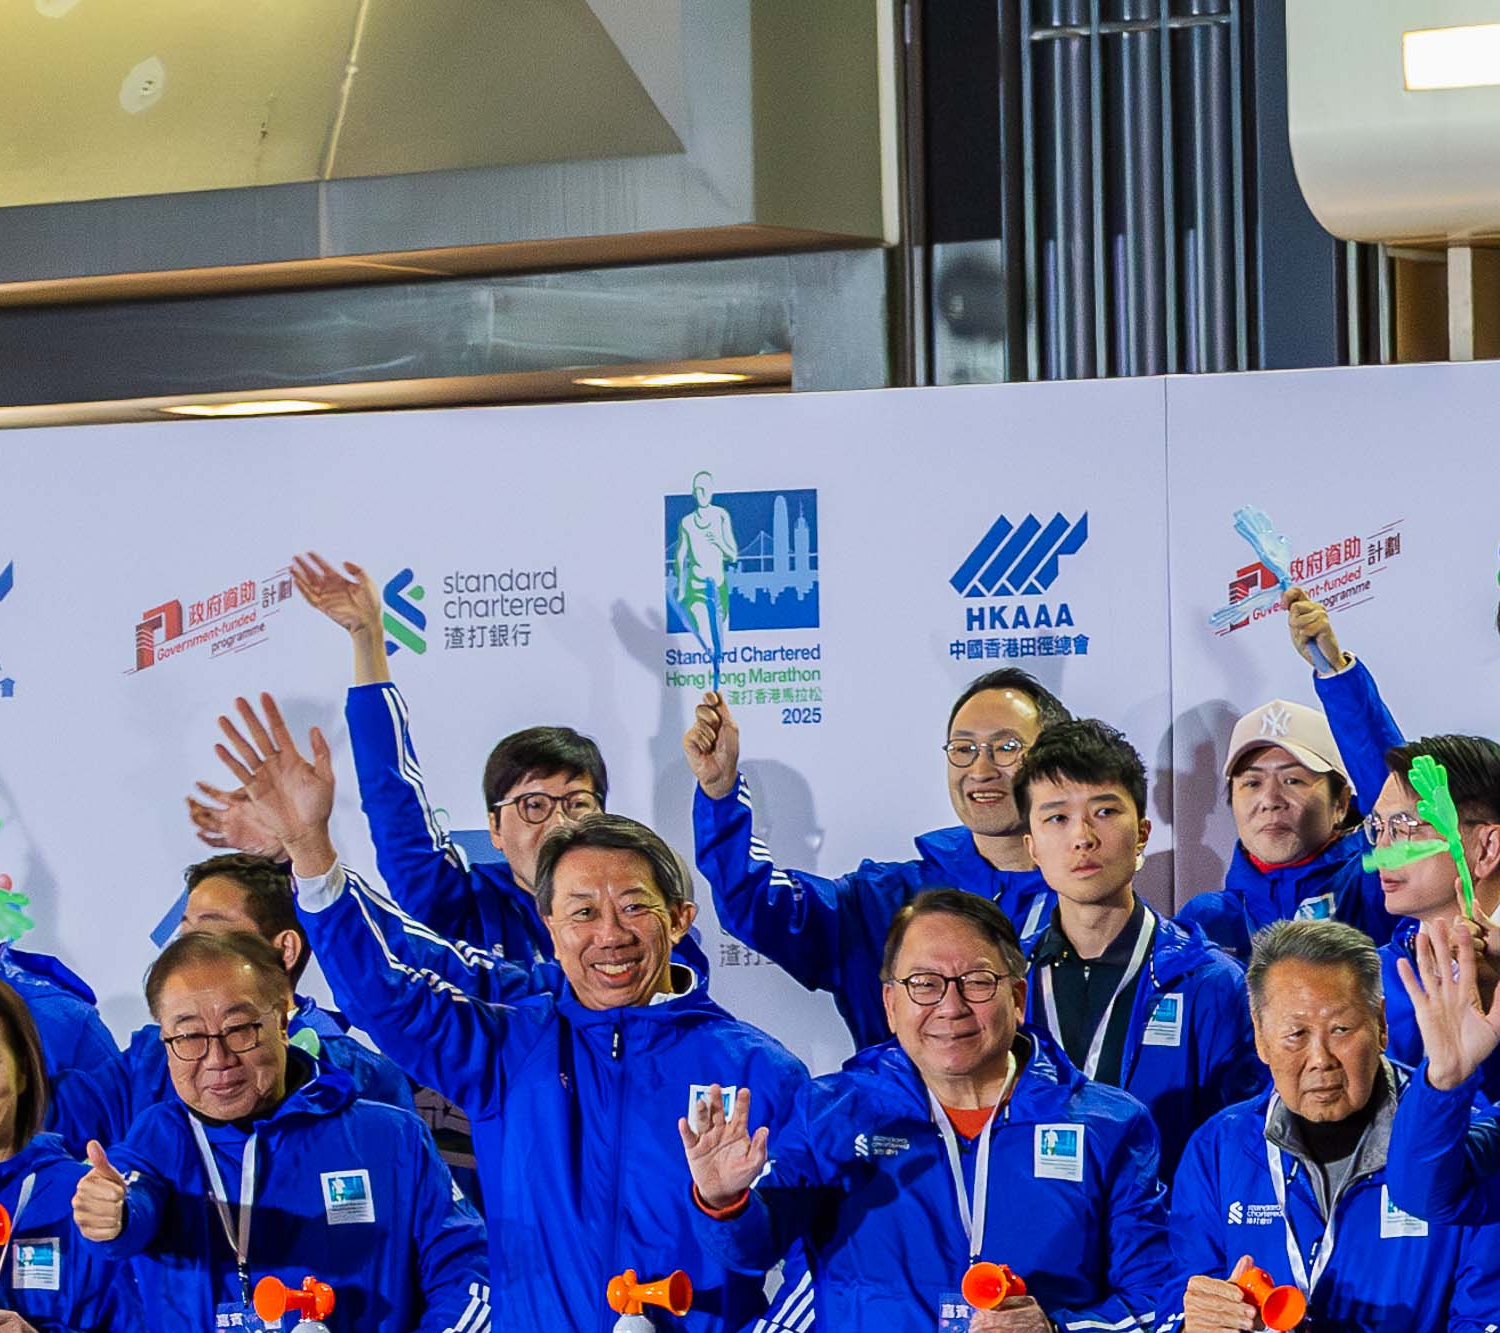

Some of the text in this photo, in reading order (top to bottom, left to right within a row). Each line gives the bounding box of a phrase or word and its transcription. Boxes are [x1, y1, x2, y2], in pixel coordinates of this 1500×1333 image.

[1367, 530, 1402, 568] 計劃
[443, 565, 558, 593] standard
[188, 579, 257, 626] 政府資助
[443, 590, 566, 619] chartered
[966, 602, 1075, 632] HKAAA
[156, 611, 257, 662] Government-funded
[211, 622, 267, 655] programme
[443, 623, 532, 650] 渣打銀行
[949, 632, 1091, 661] 中國香港田徑總會
[741, 643, 822, 664] Chartered
[665, 670, 705, 689] Hong
[748, 666, 822, 683] Marathon
[727, 686, 823, 707] 渣打香港馬拉松
[781, 707, 823, 725] 2025
